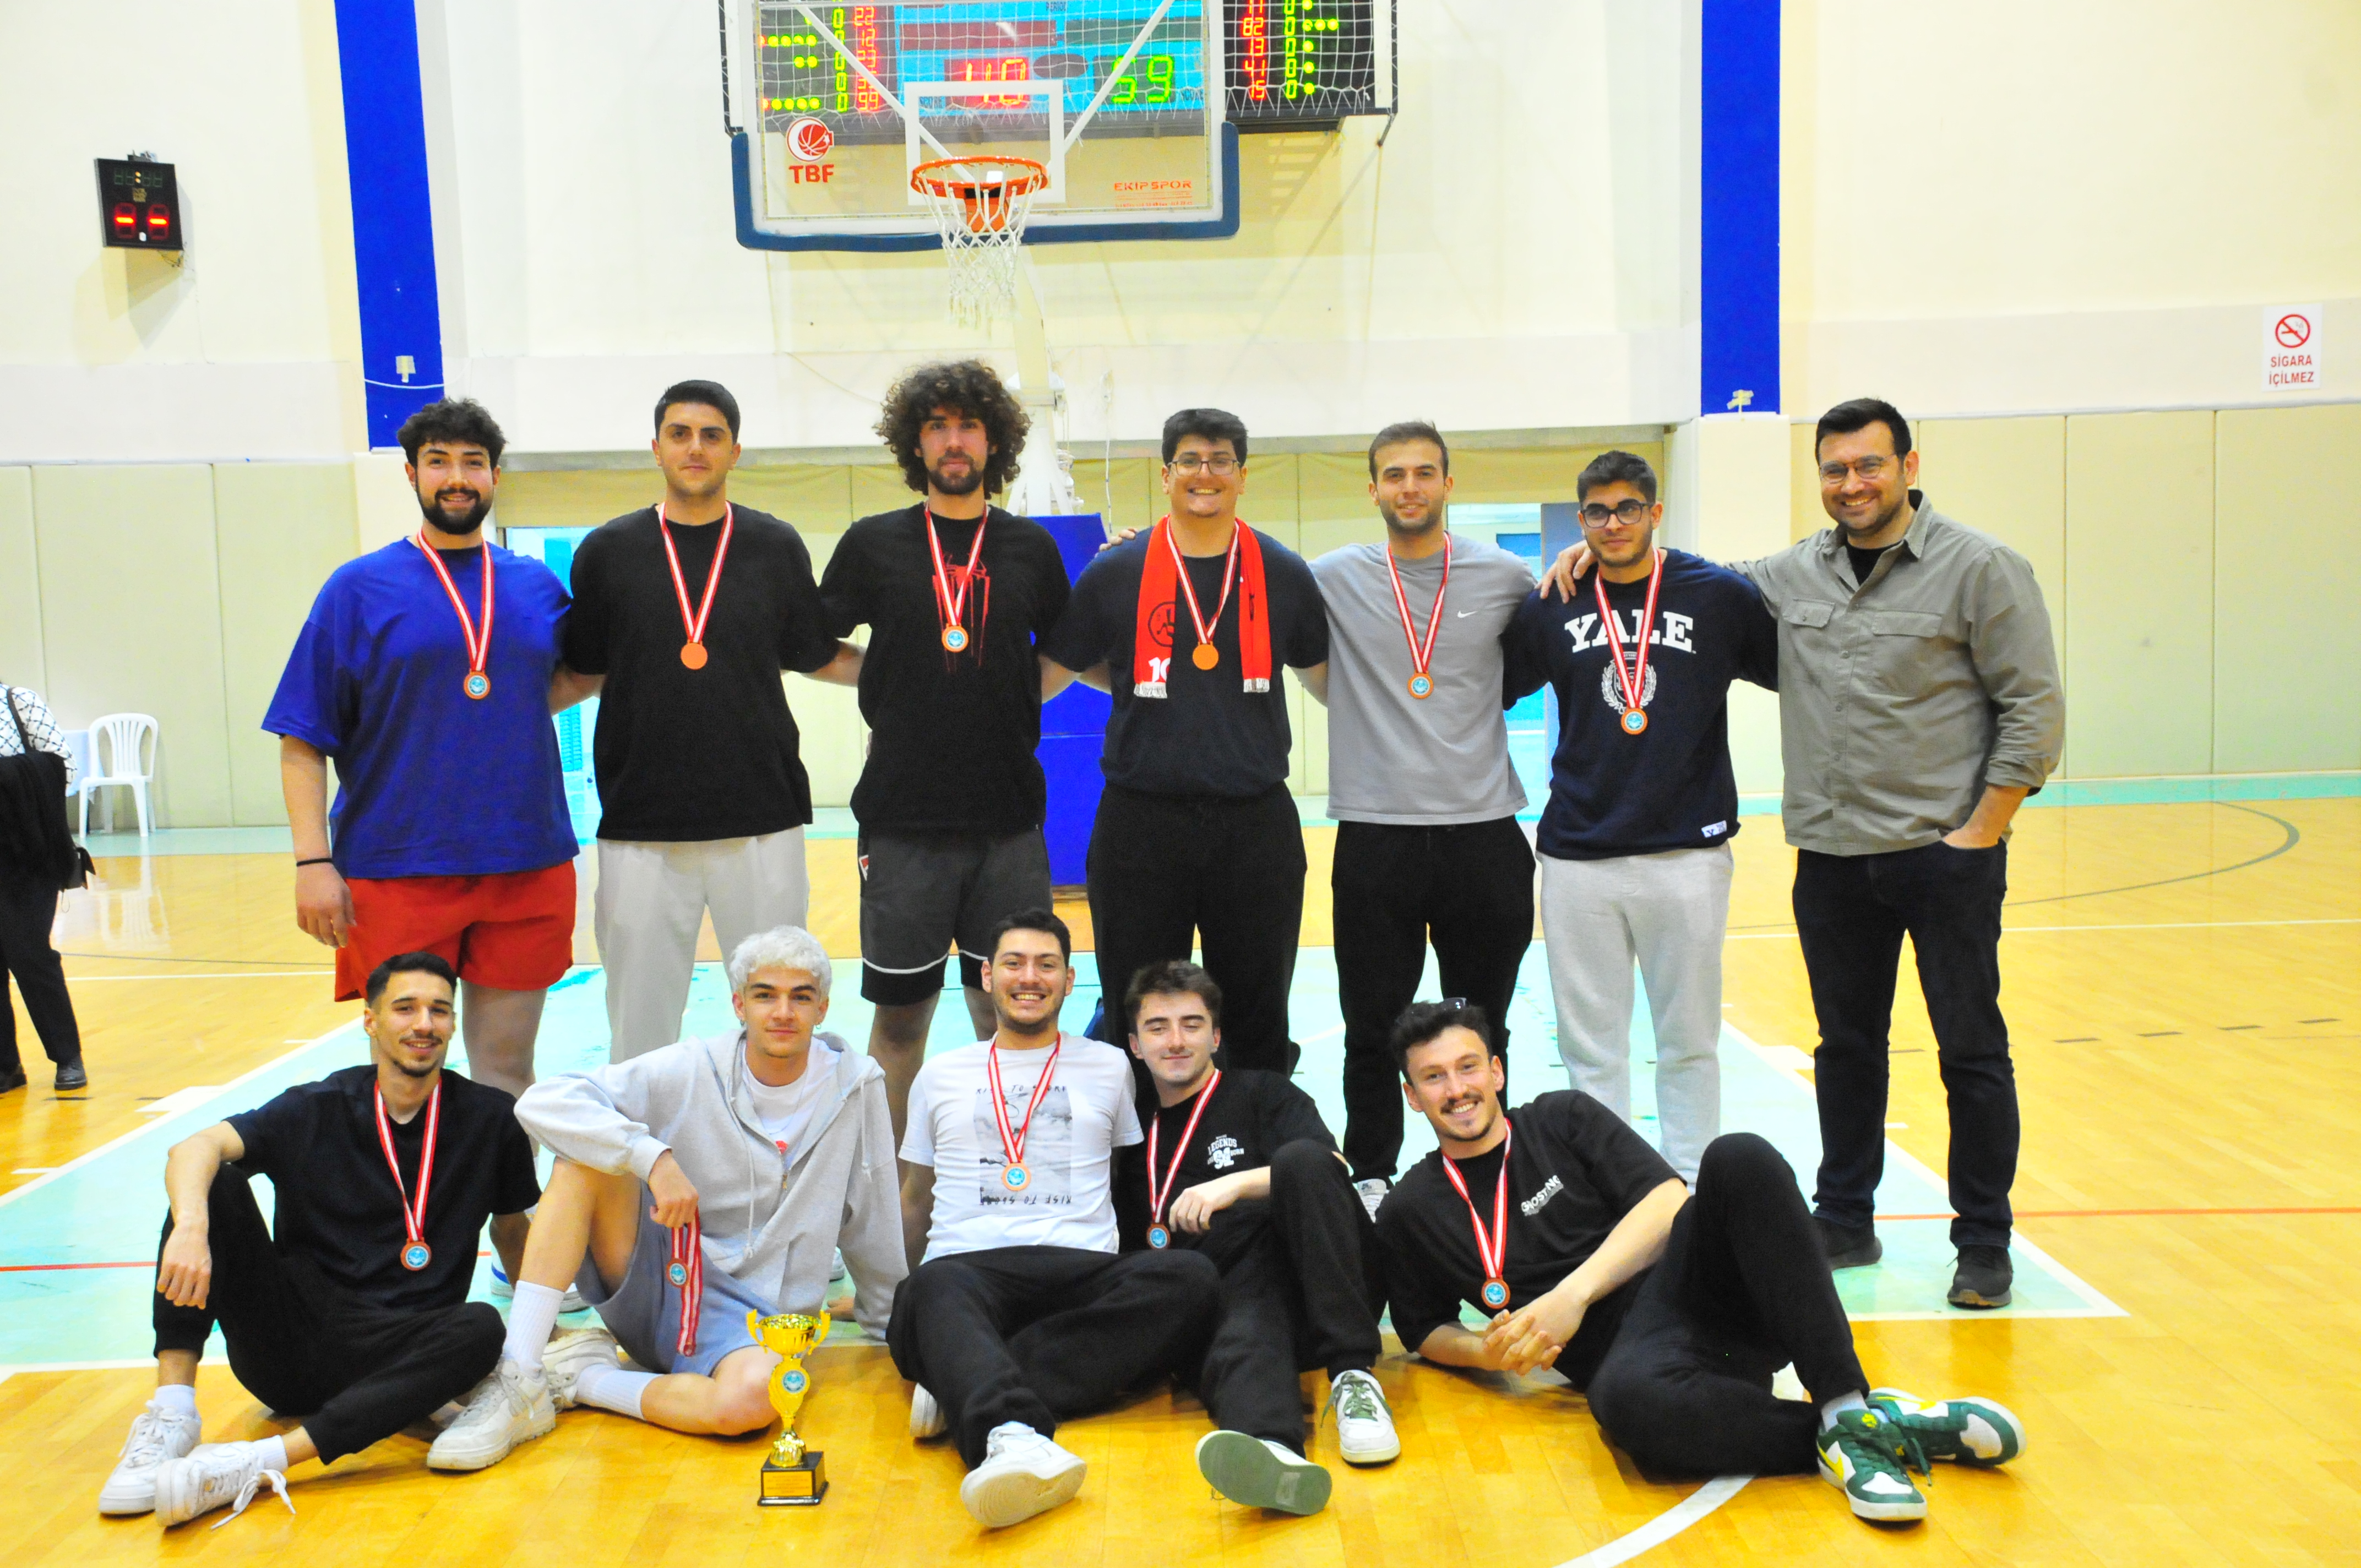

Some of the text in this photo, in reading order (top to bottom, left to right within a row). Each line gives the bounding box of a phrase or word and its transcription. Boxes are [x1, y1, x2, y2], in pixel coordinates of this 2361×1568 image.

[833, 8, 844, 28] 0
[1243, 17, 1295, 36] 82 0
[1249, 38, 1296, 57] 13 0
[1245, 58, 1297, 78] 41 0
[836, 72, 847, 91] 0
[1112, 56, 1175, 104] 59
[1286, 79, 1297, 99] 0
[837, 92, 879, 112] 0 99
[788, 164, 834, 184] TBF
[2270, 353, 2313, 368] SİGARA
[2269, 371, 2314, 387] İÇİLMEZ
[1564, 609, 1694, 653] YALE
